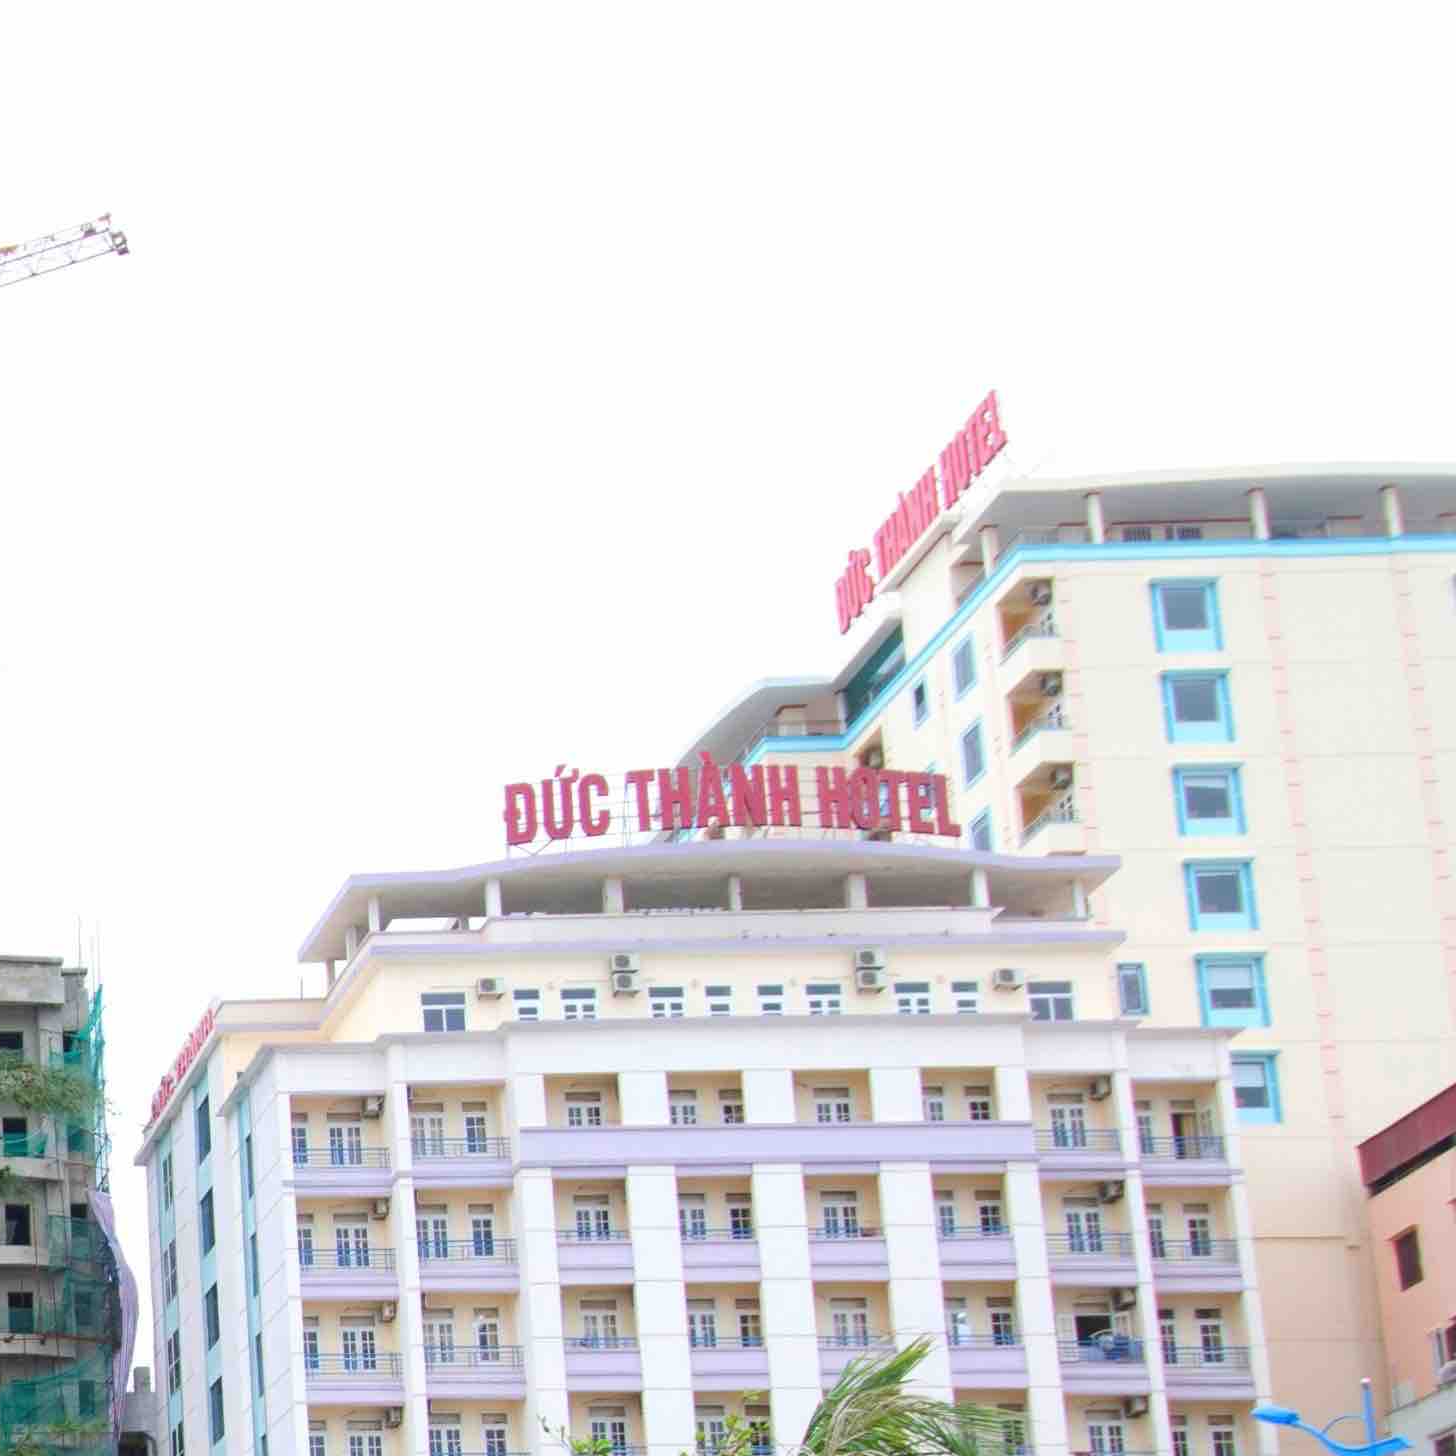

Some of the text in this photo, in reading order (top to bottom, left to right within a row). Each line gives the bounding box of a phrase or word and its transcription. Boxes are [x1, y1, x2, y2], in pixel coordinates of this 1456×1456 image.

[503, 750, 963, 846] ĐỨC THÀNH HOTEL
